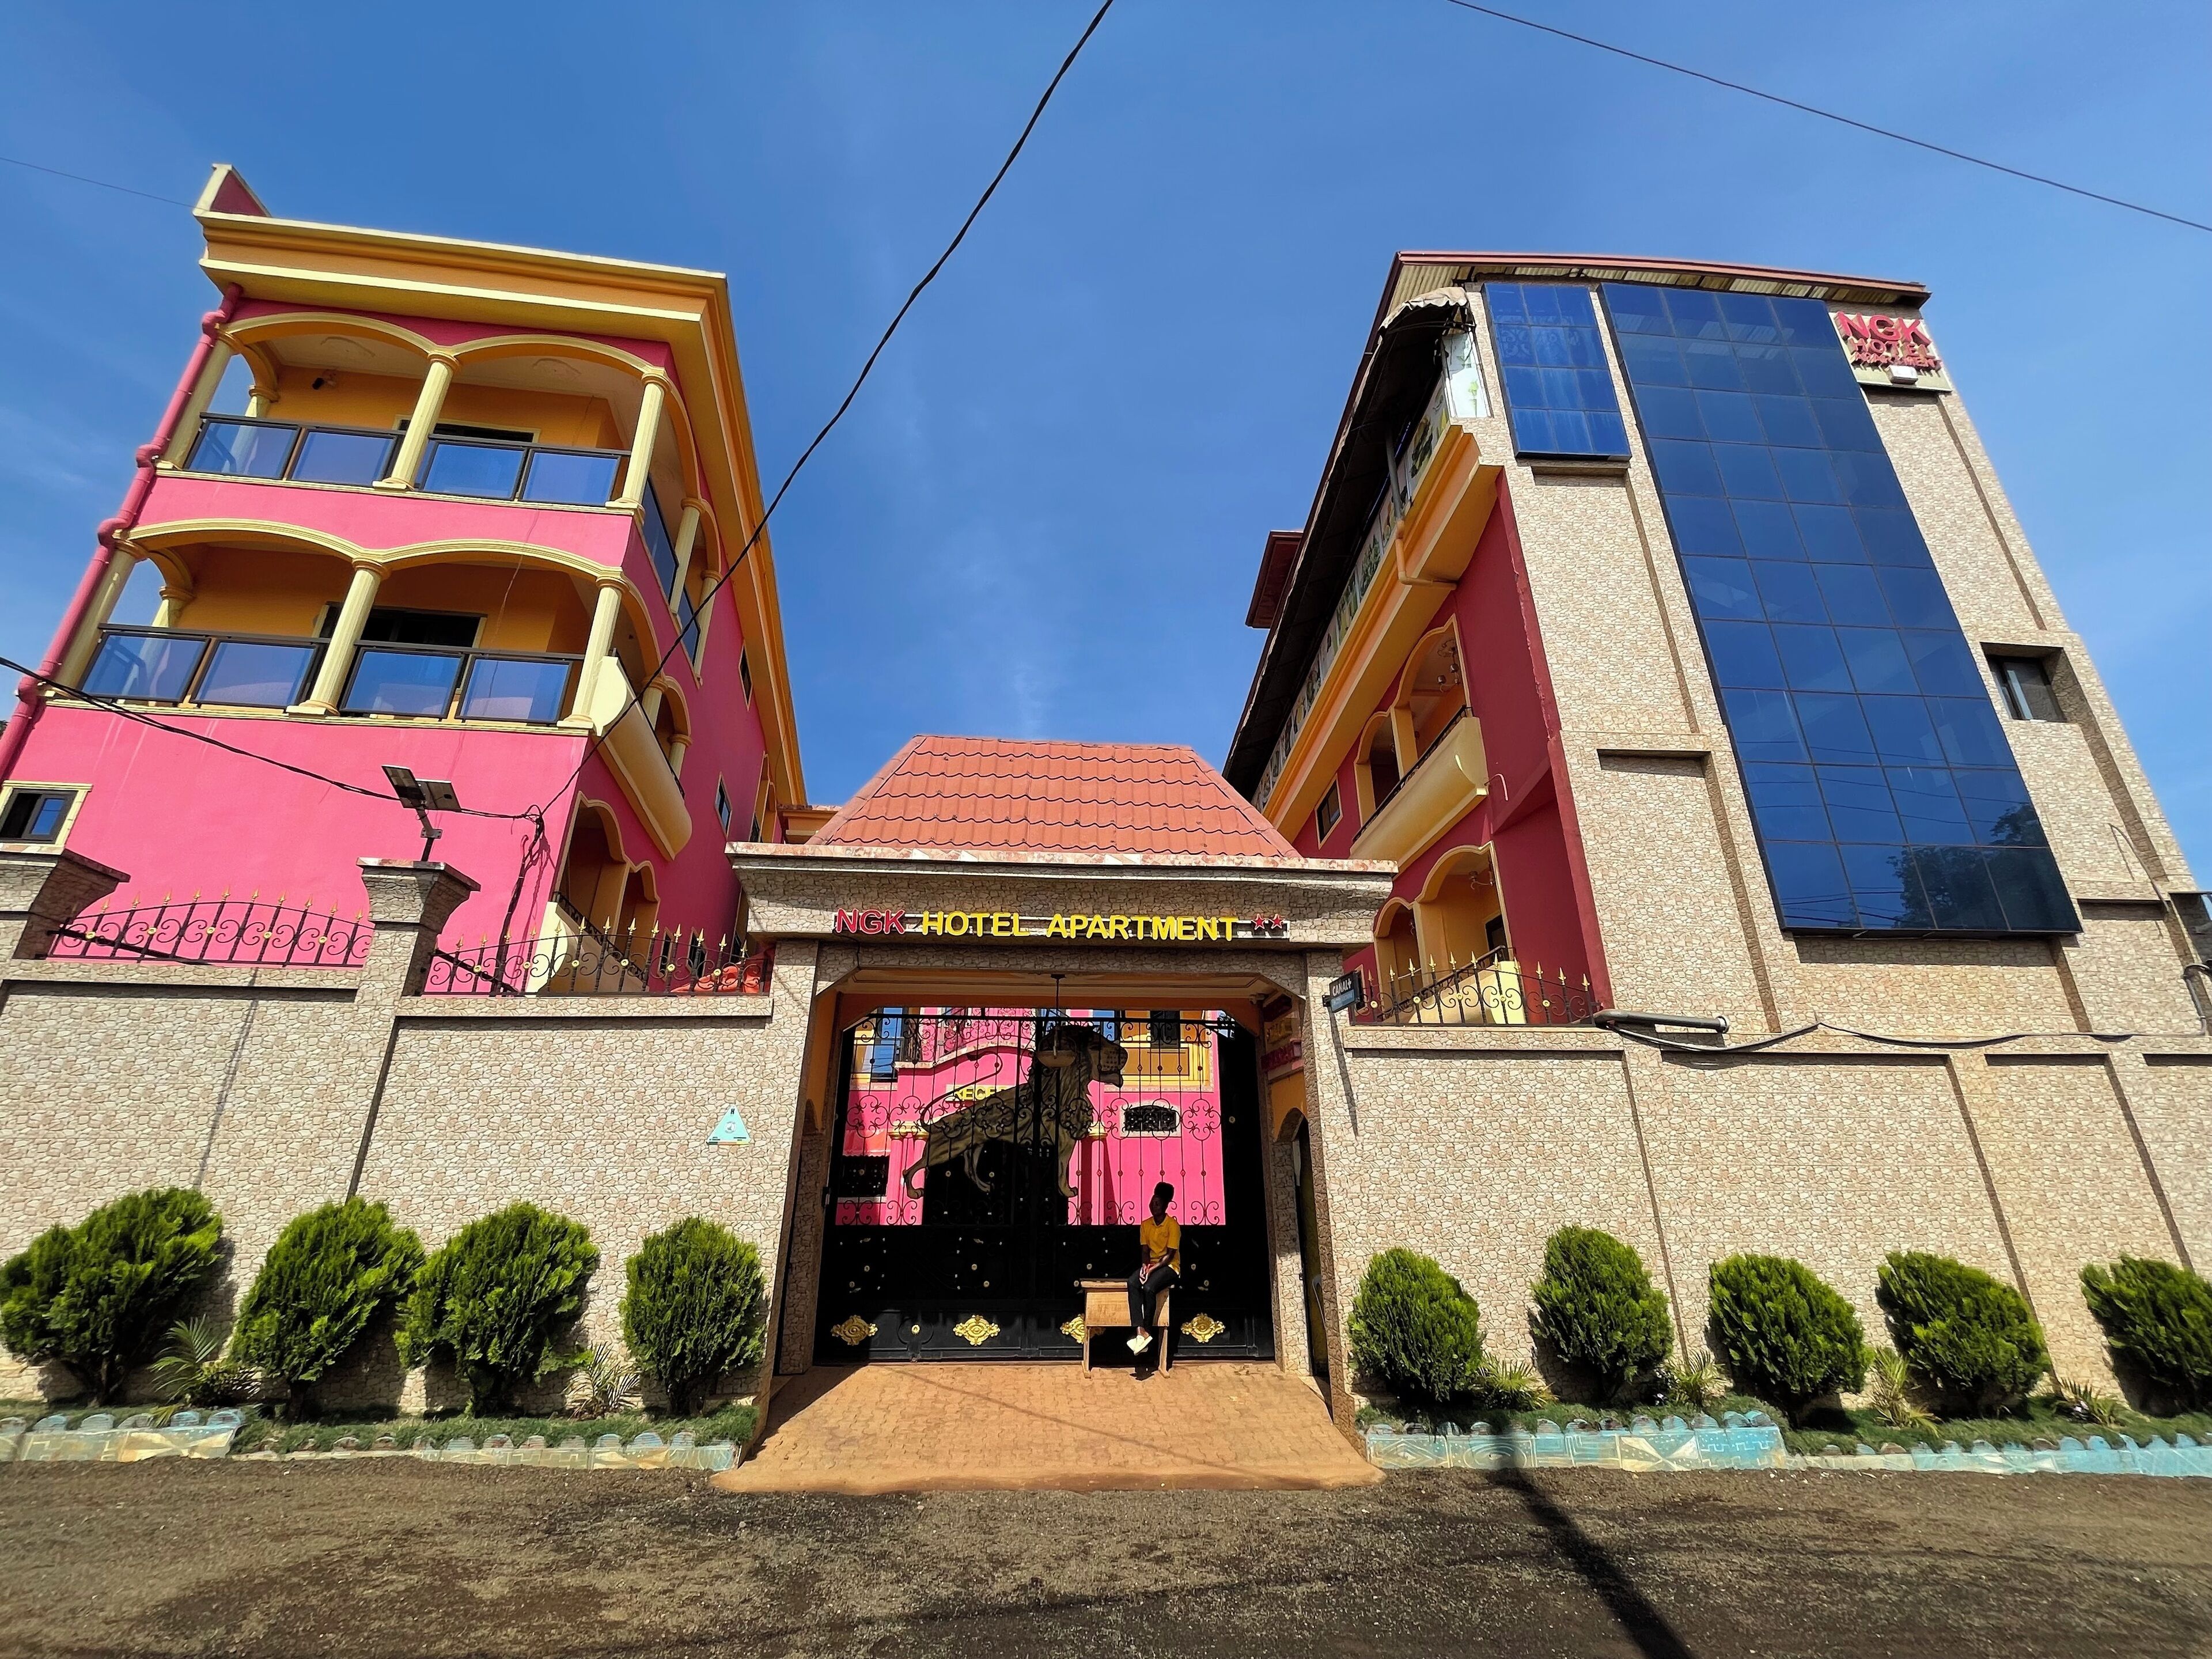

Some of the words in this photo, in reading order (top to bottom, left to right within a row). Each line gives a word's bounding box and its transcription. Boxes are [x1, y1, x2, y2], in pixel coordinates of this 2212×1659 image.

[1836, 310, 1932, 346] NGK
[1847, 338, 1936, 359] HOTEL
[835, 908, 906, 934] NGK
[922, 910, 1030, 937] HOTEL
[1046, 913, 1239, 941] APARTMENT
[1332, 978, 1352, 997] CANAL+
